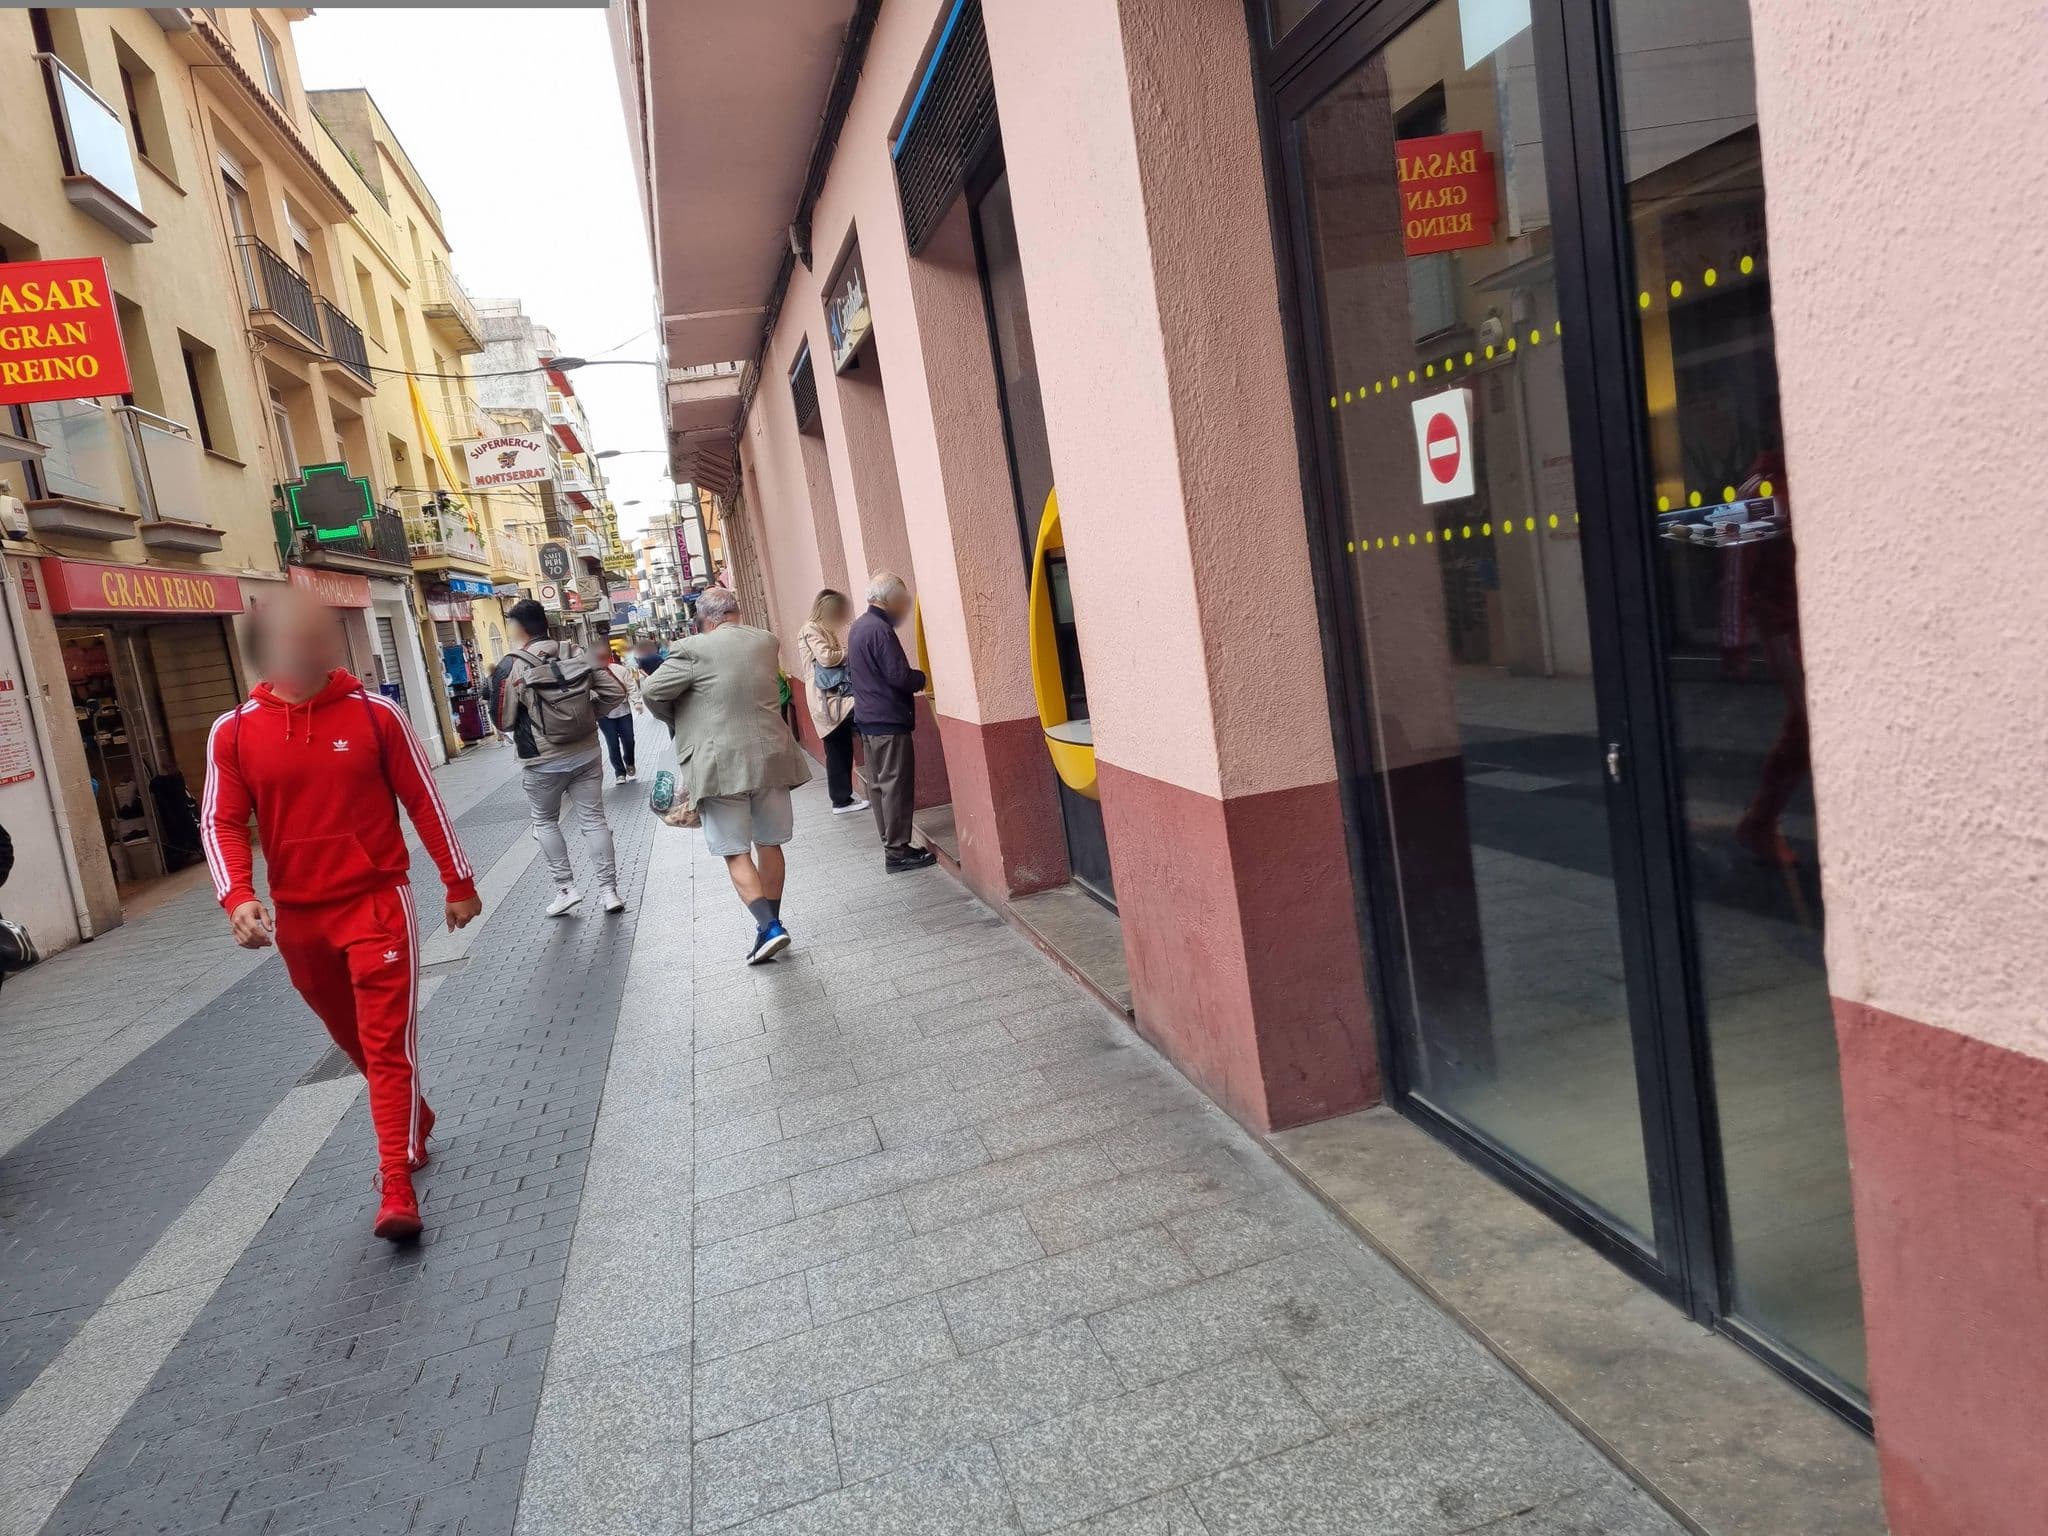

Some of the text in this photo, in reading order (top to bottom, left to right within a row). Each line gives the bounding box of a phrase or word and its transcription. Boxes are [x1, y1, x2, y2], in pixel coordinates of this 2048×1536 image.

[0, 321, 87, 351] GRAN
[0, 354, 99, 385] REINO
[470, 437, 541, 460] SUPERMERCAT
[475, 467, 546, 486] MONTSERRAT
[605, 504, 620, 549] HOTEL
[548, 565, 562, 575] 70
[604, 553, 636, 562] ARMONIA
[101, 571, 216, 609] GRAN REINO
[312, 576, 355, 604] FARMACIA
